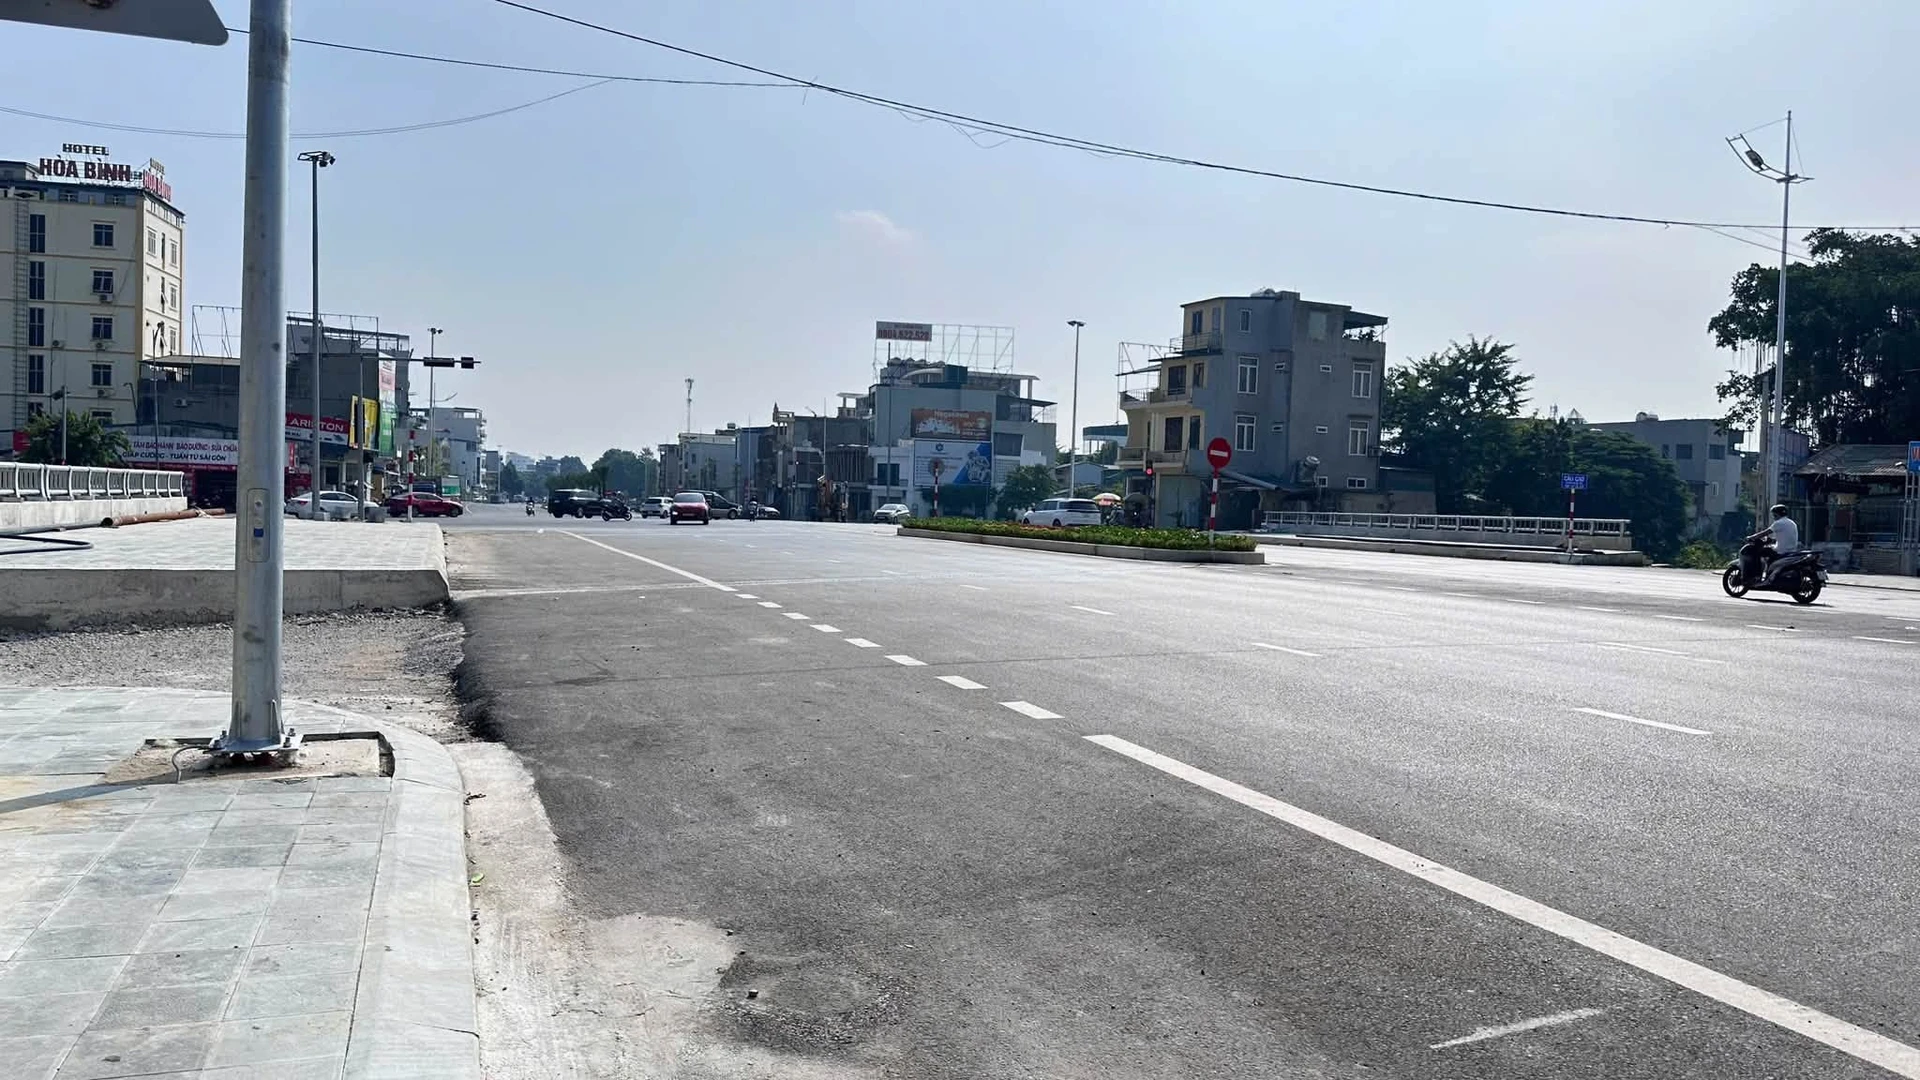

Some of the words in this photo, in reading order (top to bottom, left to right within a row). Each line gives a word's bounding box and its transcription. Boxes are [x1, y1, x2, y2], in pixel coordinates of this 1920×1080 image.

[62, 143, 110, 156] HOTEL
[39, 154, 79, 178] HÒA
[84, 157, 131, 182] BÌNH
[289, 417, 344, 432] ARITON
